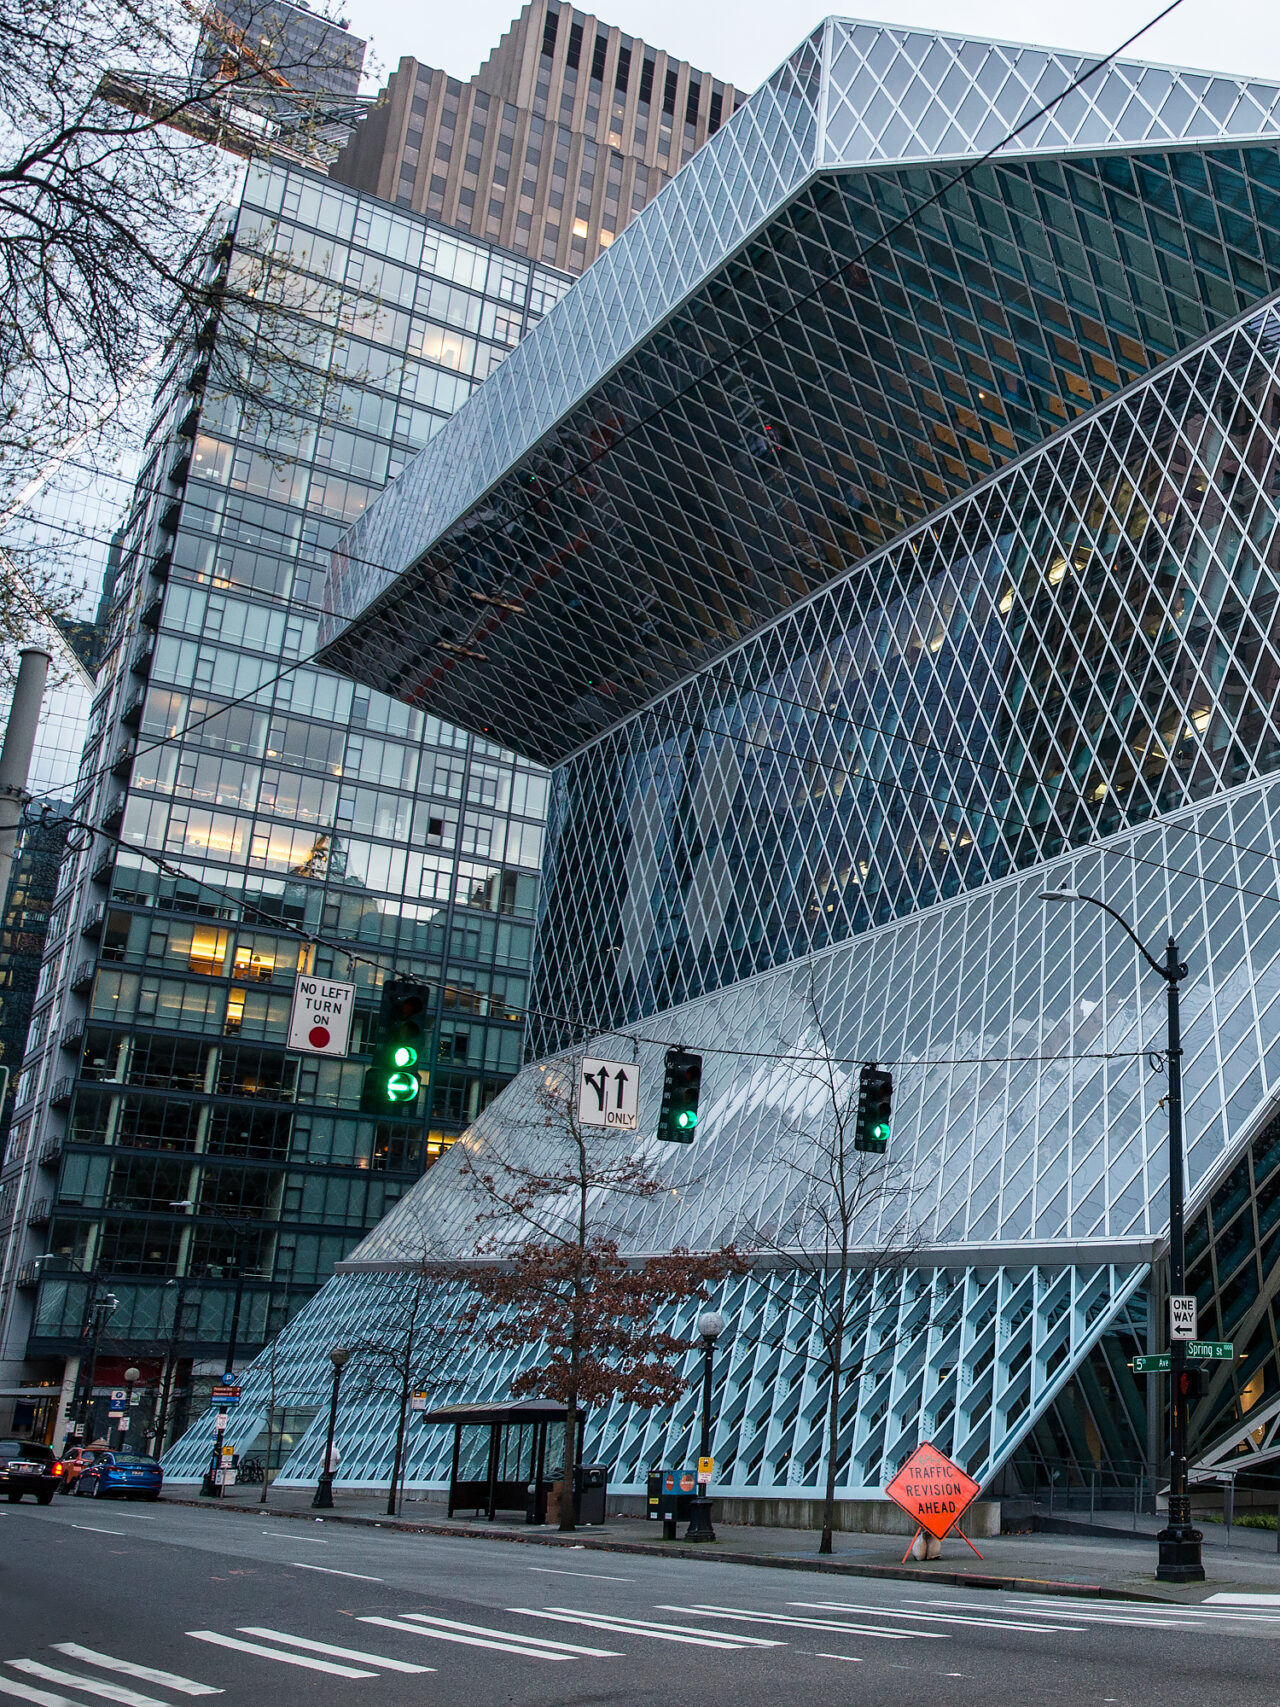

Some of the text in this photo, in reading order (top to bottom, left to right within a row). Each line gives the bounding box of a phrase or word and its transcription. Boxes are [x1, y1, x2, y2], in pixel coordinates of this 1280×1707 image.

[301, 982, 351, 1000] NO LEFT
[306, 997, 342, 1014] TURN
[313, 1015, 329, 1025] ON
[607, 1112, 635, 1125] ONLY
[1173, 1299, 1194, 1311] ONE
[1173, 1311, 1194, 1322] WAY
[1188, 1342, 1213, 1357] Spring
[1216, 1346, 1223, 1356] St
[1158, 1359, 1169, 1367] Ave
[908, 1466, 953, 1479] TRAFFIC
[906, 1483, 961, 1497] REVISION
[918, 1501, 956, 1514] AHEAD
